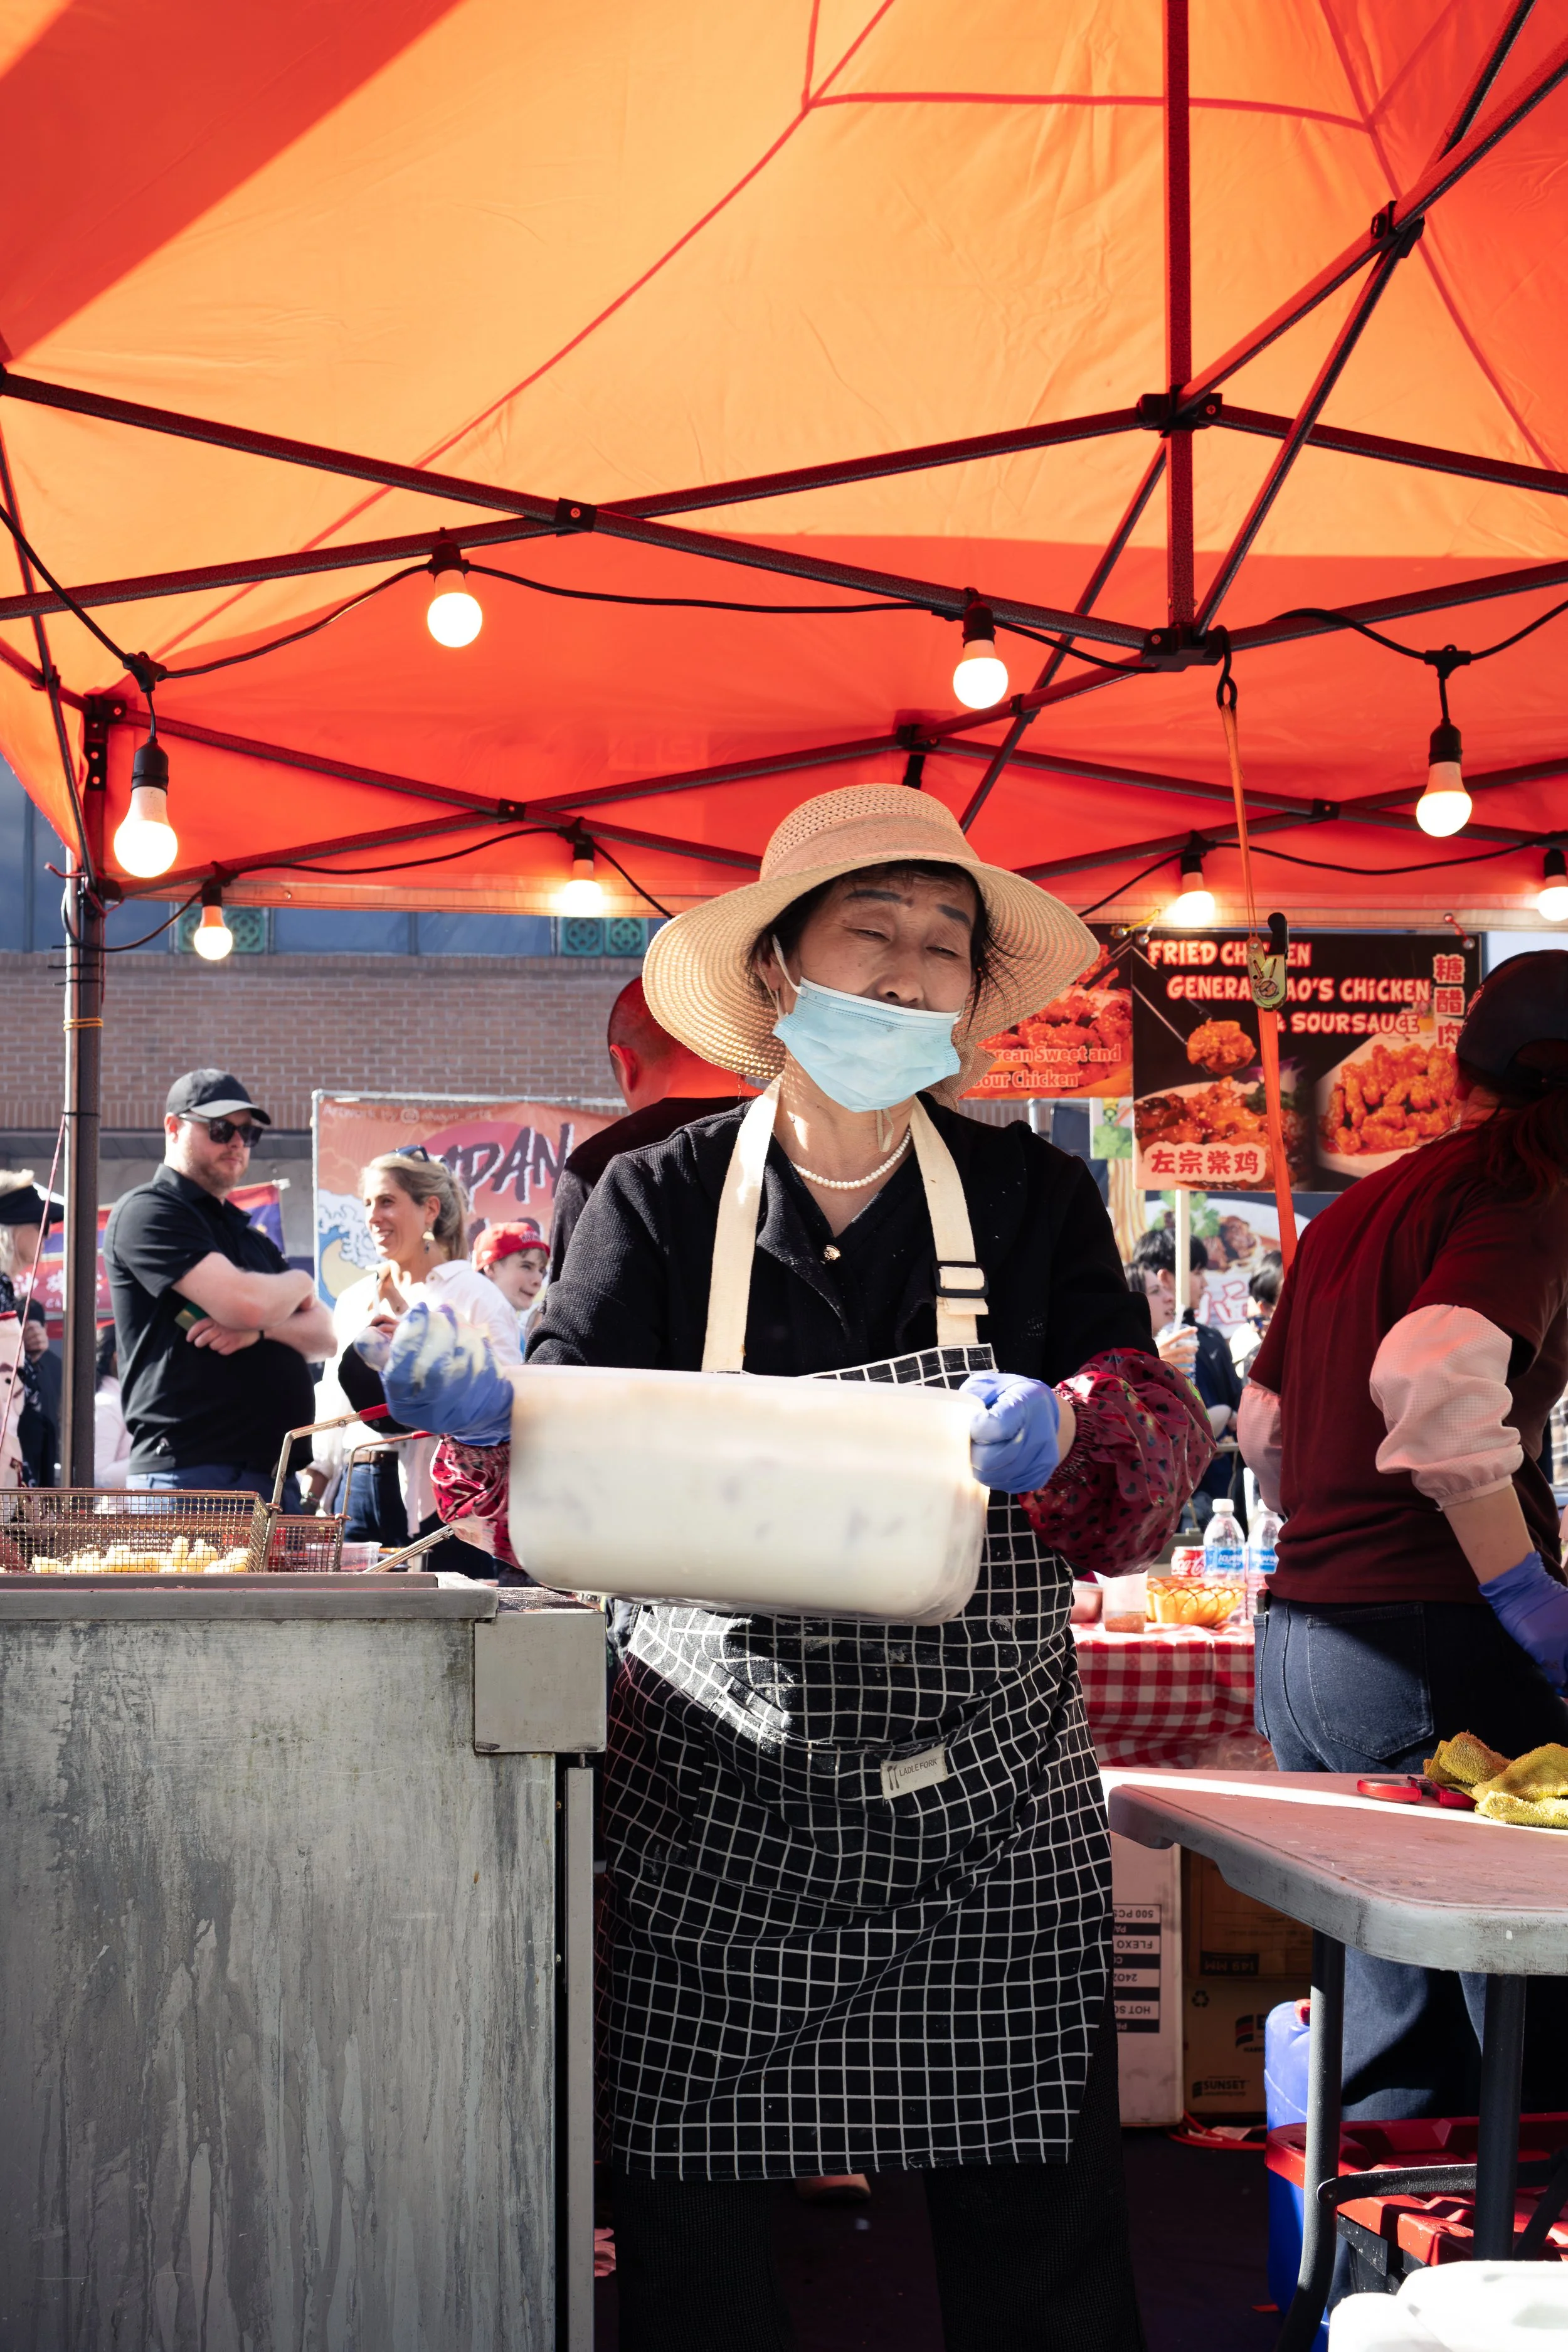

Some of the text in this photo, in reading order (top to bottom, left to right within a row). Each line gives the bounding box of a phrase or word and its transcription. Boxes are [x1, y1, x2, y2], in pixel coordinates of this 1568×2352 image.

[1148, 940, 1311, 967] FRIED CHEN
[1167, 976, 1254, 1000] GENERA
[1286, 977, 1334, 1002] AO'S
[994, 1044, 1121, 1062] rean Sweet and
[1012, 1070, 1078, 1088] Chicken
[1151, 1149, 1259, 1175] 左宗棠鸡
[1136, 1909, 1153, 1918] 500
[1116, 1940, 1153, 1949] FLEXO
[1129, 2005, 1150, 2014] HOT
[1204, 2080, 1244, 2090] SUNSET
